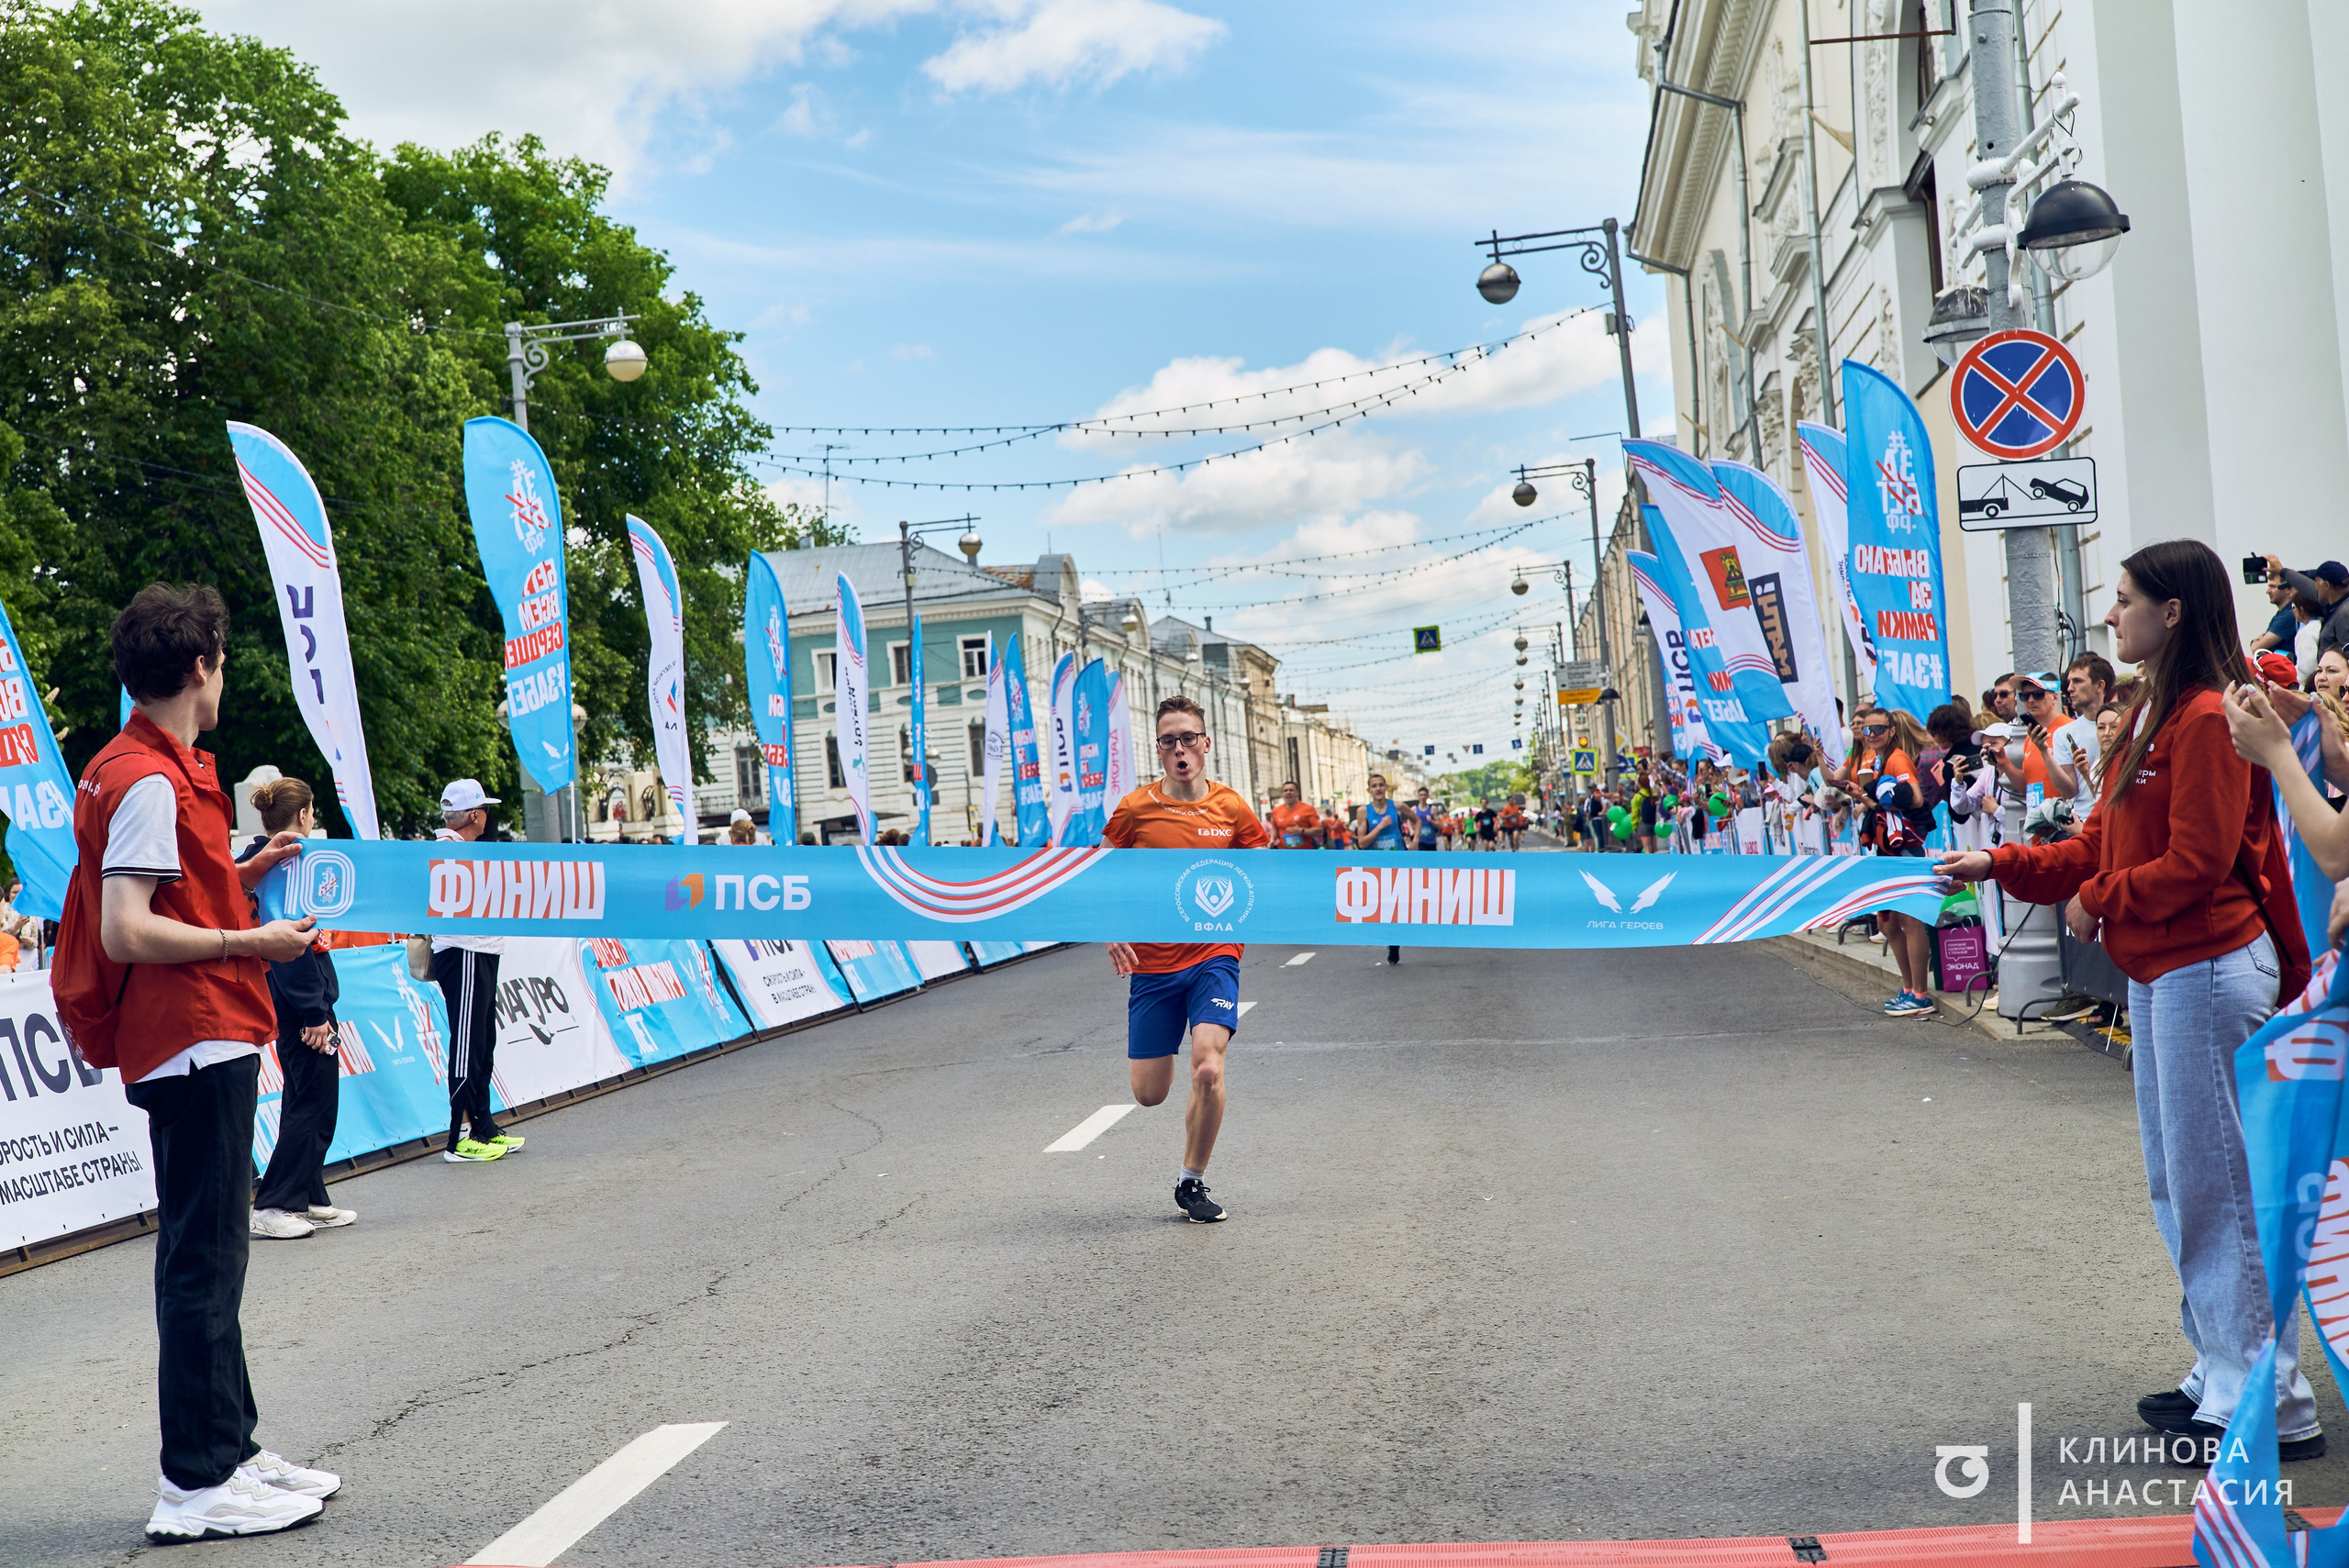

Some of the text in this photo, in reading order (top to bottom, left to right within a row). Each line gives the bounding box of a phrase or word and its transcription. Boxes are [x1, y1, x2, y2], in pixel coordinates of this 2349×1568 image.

[1211, 828, 1232, 837] DKC
[429, 860, 606, 919] ФИНИШ
[716, 874, 812, 911] ПСБ
[1174, 859, 1255, 924] ВСЕРОССИЙСКАЯ ФЕДЕРАЦИЯ ЛЕГКОЙ АТЛЕТИКИ
[1335, 866, 1516, 927] ФИНИШ
[1194, 922, 1234, 932] ВФЛА
[1586, 920, 1664, 930] ЛИГА ГЕРОЕВ
[1946, 962, 1979, 971] ЭКОНАД
[495, 976, 570, 1030] МАГУРО
[1210, 997, 1234, 1011] RAY
[0, 1134, 52, 1166] РОСТЬ
[49, 1130, 65, 1153] И
[63, 1121, 110, 1151] СИЛА
[0, 1150, 143, 1206] МАСШТАБЕ СТРАНЫ
